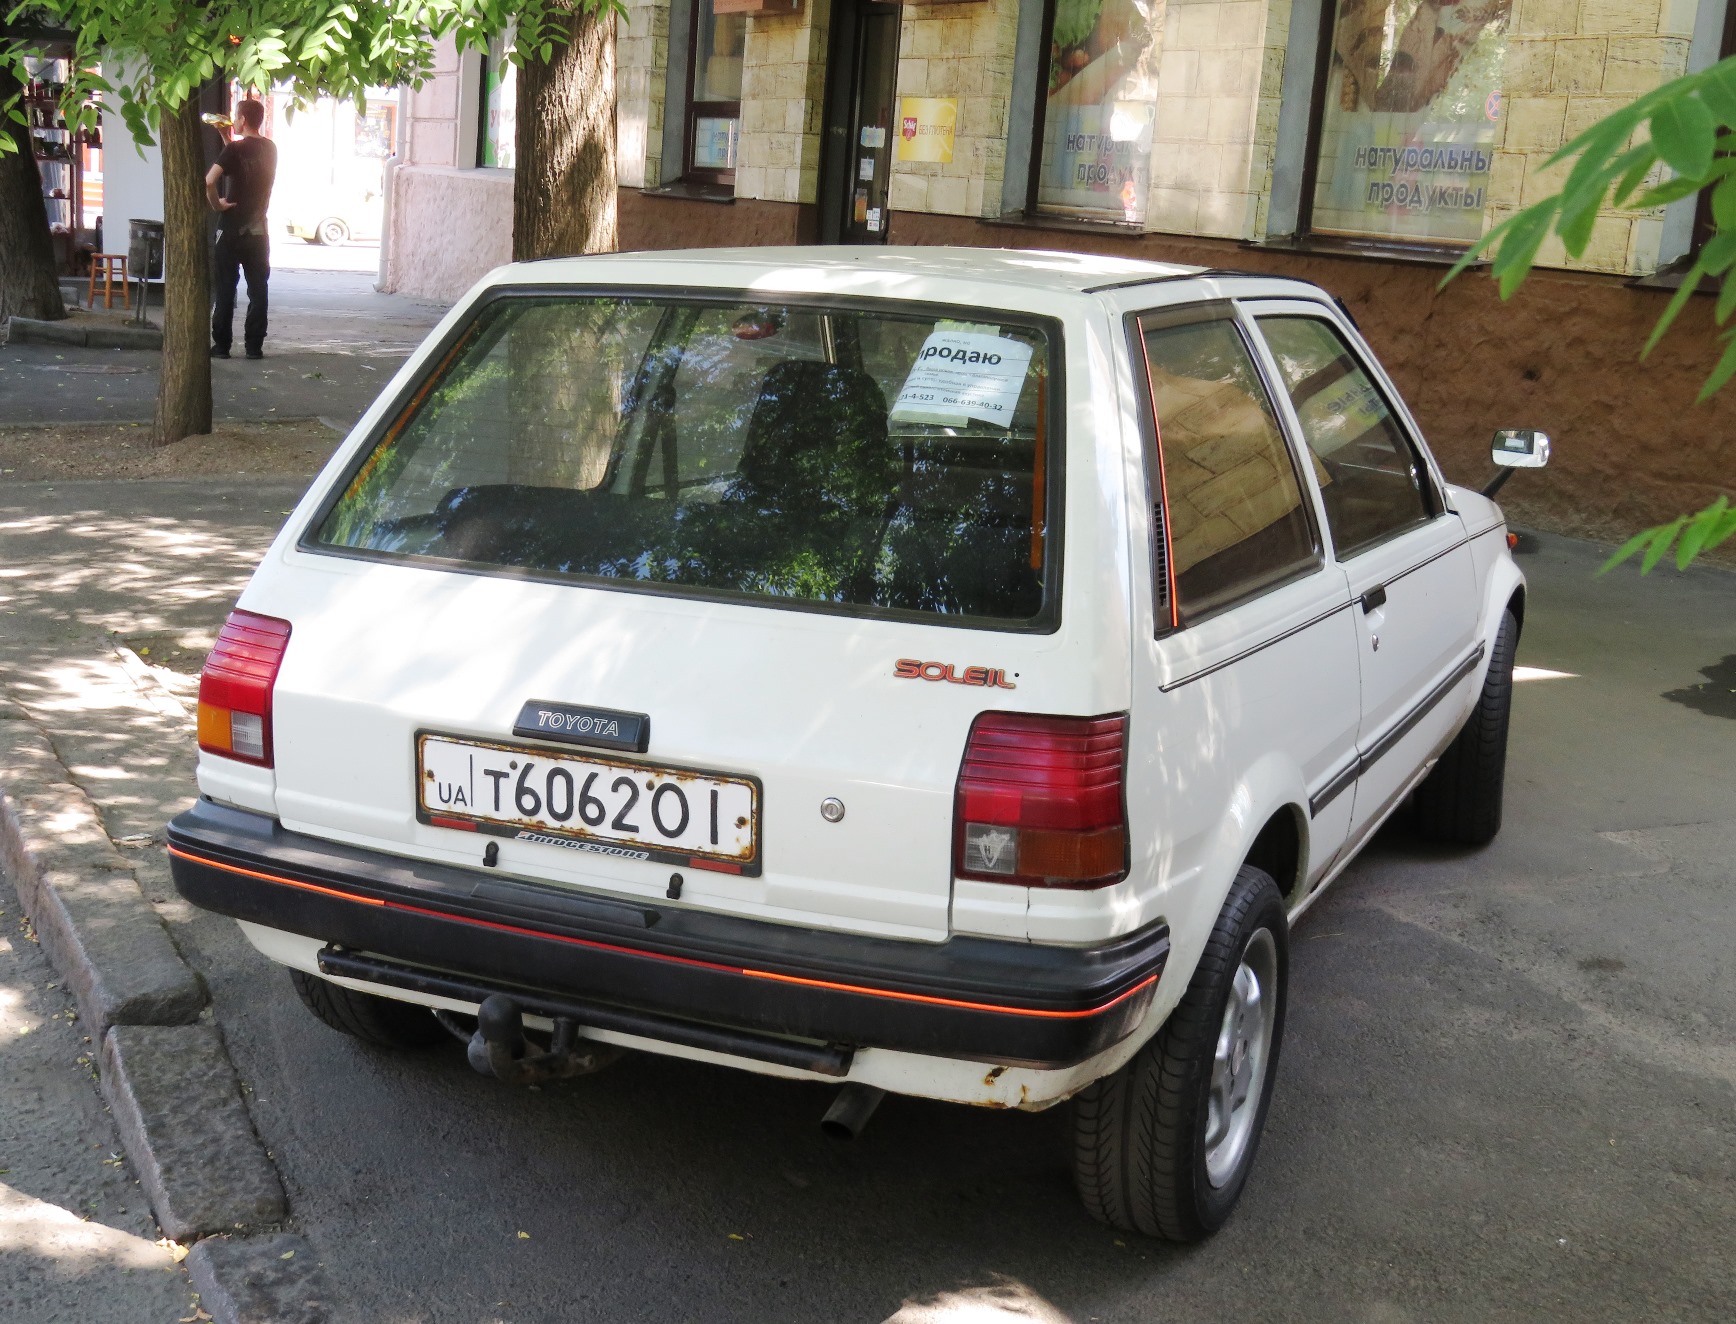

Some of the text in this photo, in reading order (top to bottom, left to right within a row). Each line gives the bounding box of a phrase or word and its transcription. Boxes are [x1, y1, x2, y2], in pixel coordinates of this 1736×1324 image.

[1368, 181, 1482, 212] продукты
[893, 658, 1016, 689] SOLEIL
[538, 711, 619, 736] TOYOTA
[439, 782, 467, 807] UA
[515, 831, 650, 860] BRIDGESTONE
